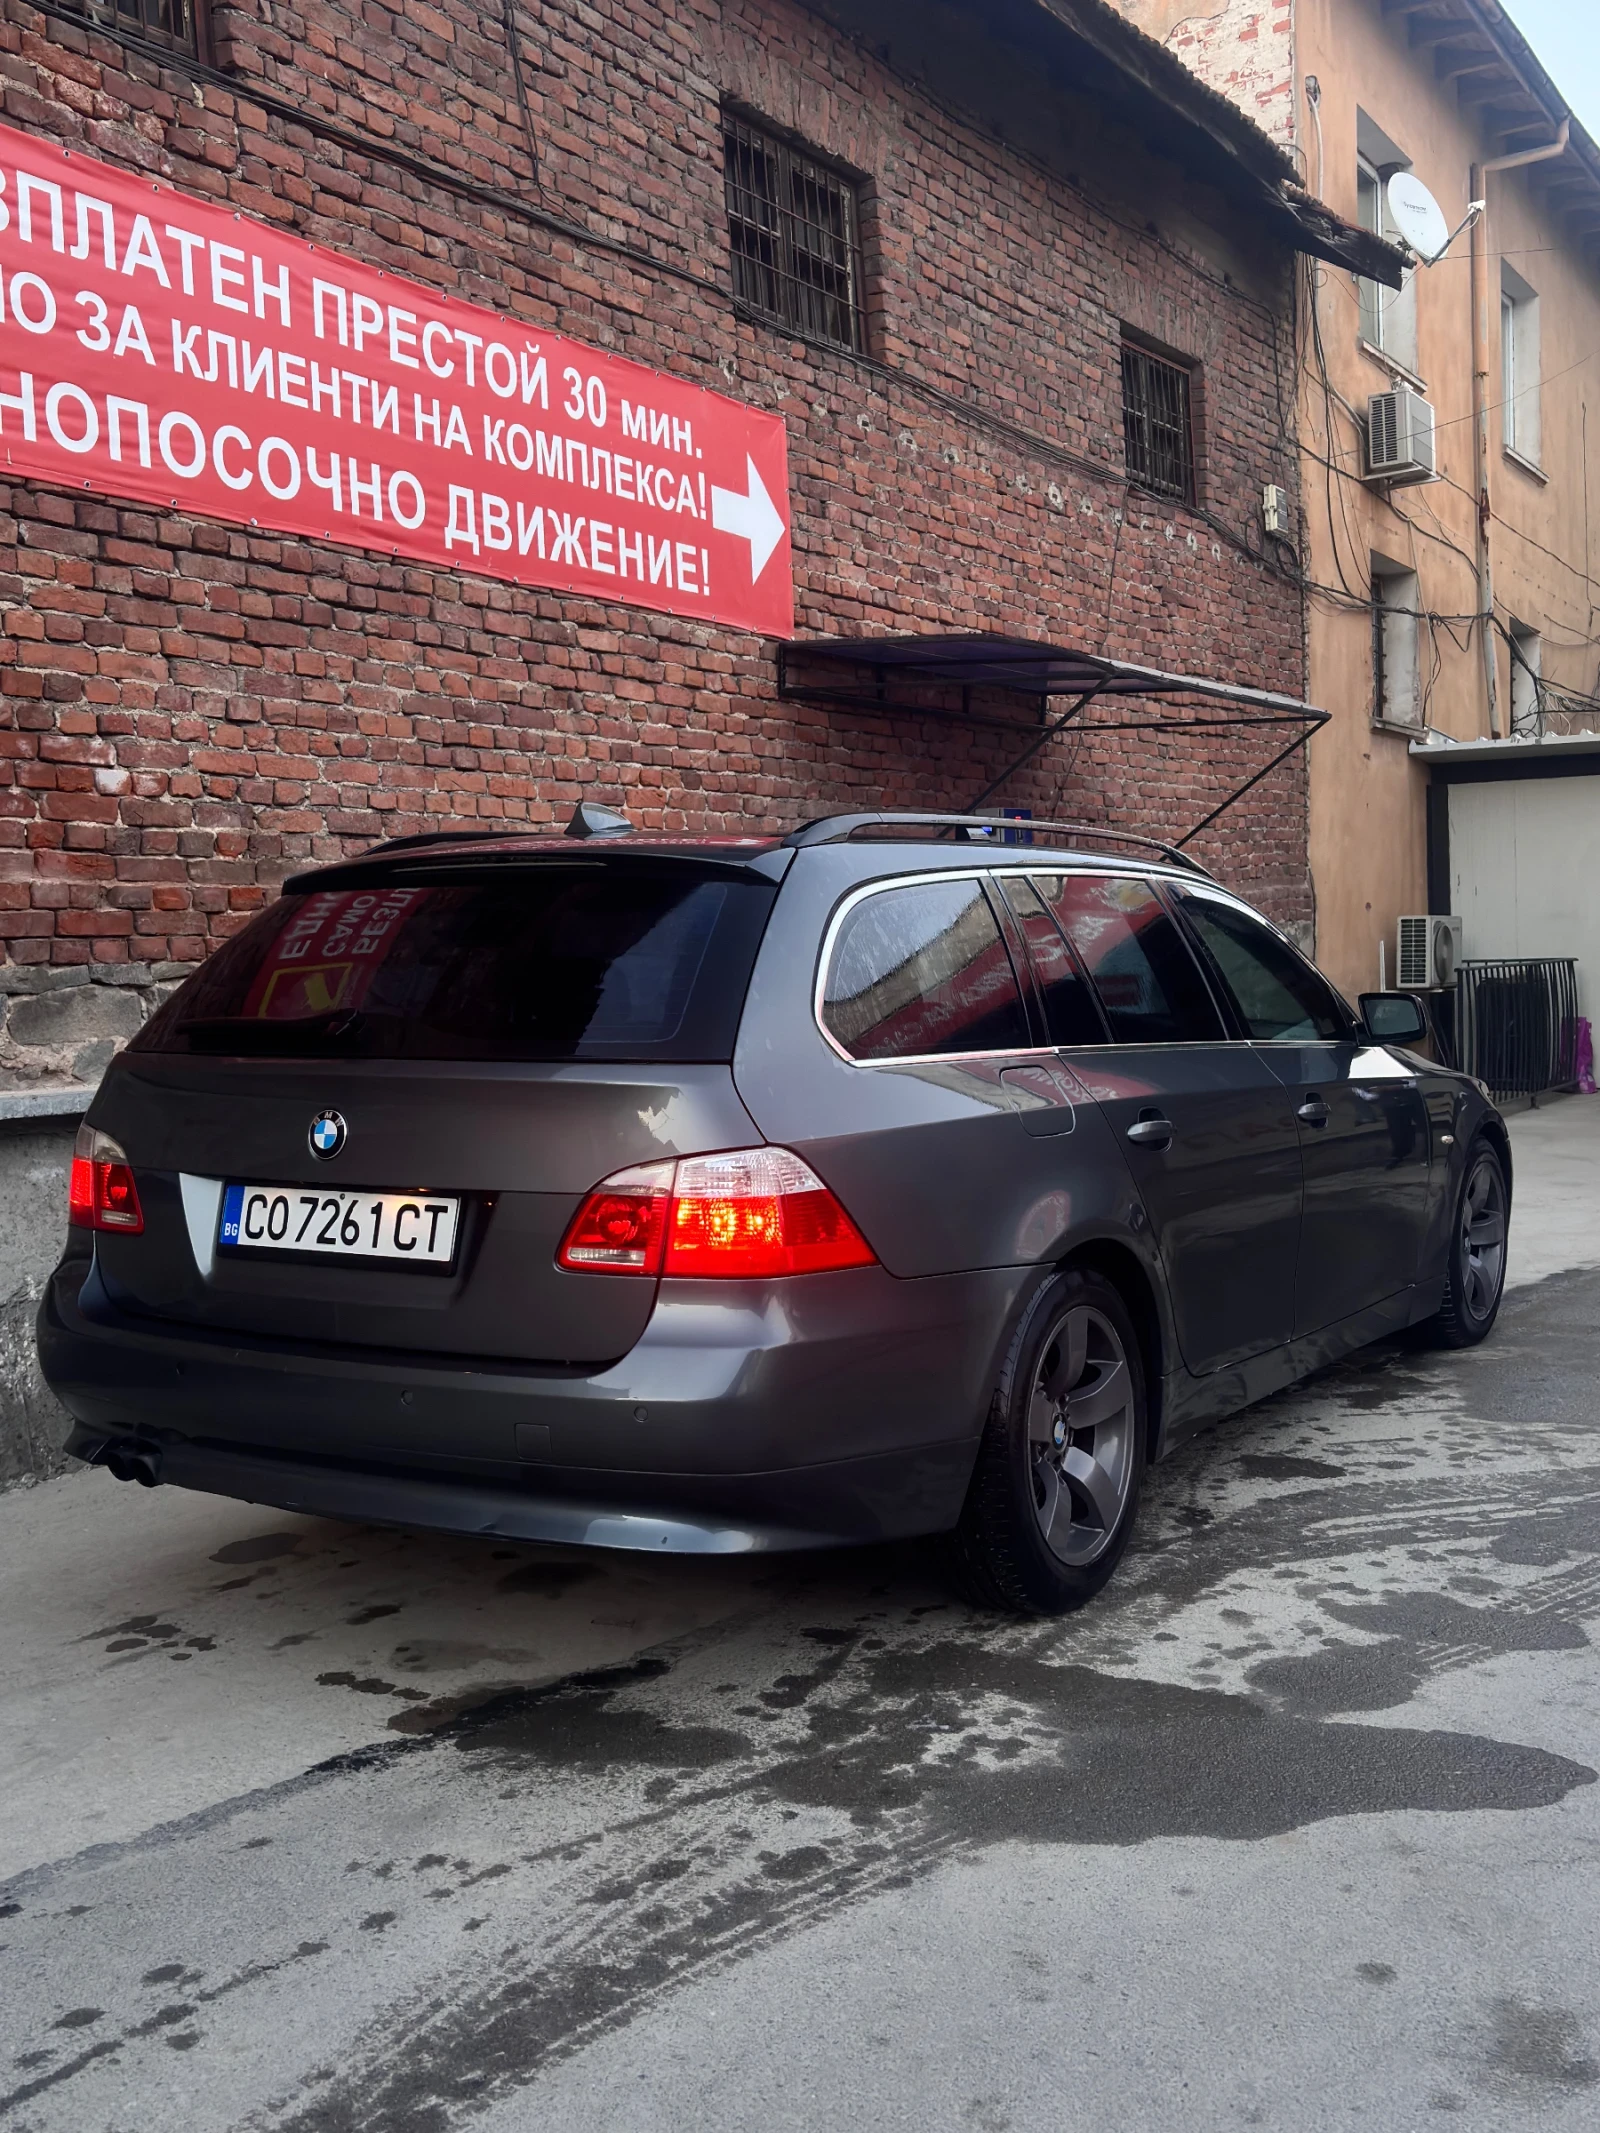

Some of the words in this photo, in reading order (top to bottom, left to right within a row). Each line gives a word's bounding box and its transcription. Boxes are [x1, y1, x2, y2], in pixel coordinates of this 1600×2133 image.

[0, 170, 292, 328] ПЛАТЕН
[313, 277, 548, 410] ПРЕСТОЙ
[563, 367, 607, 428] 30
[0, 264, 57, 335] О
[74, 290, 157, 366] ЗА
[172, 318, 400, 435] КЛИЕНТИ
[414, 393, 473, 456] НА
[484, 415, 707, 521] КОМПЛЕКСА!
[445, 483, 711, 597] ДВИЖЕНИЕ!
[224, 1223, 239, 1238] BG
